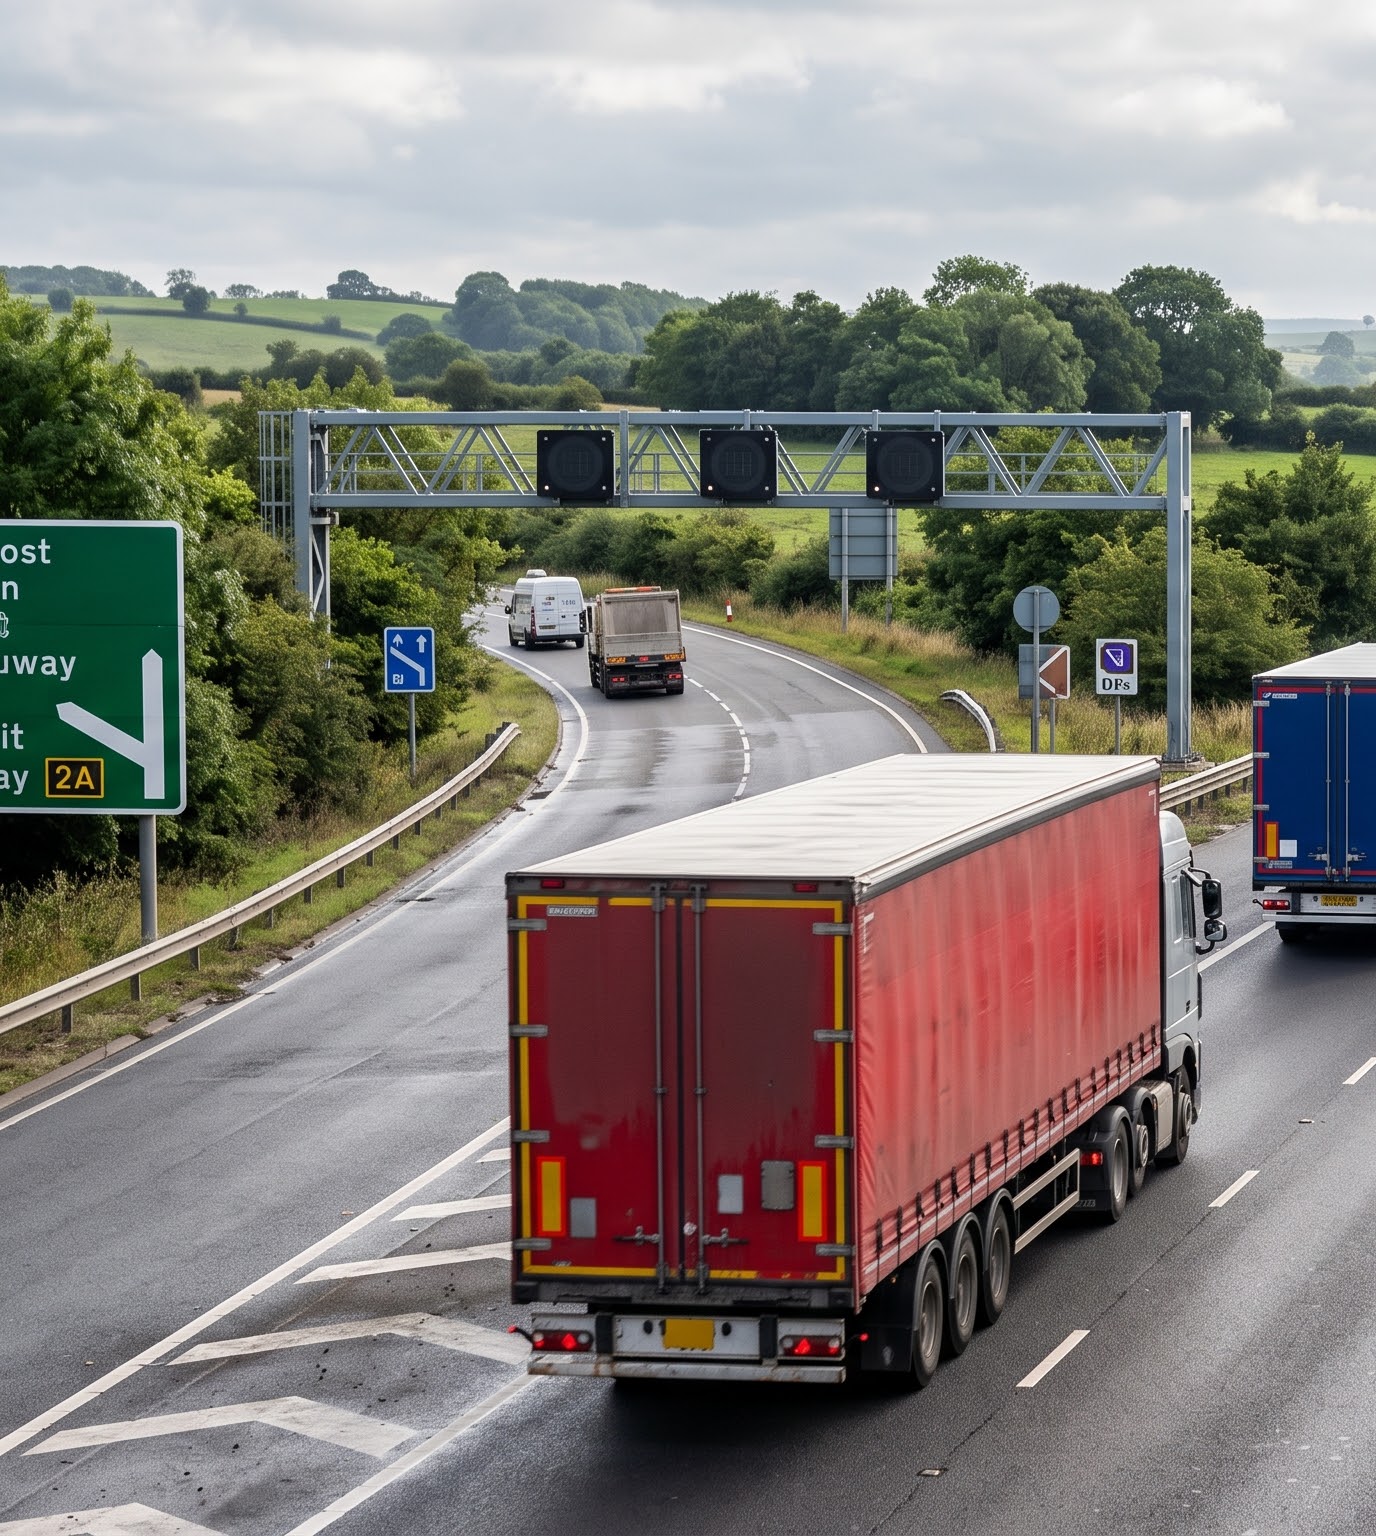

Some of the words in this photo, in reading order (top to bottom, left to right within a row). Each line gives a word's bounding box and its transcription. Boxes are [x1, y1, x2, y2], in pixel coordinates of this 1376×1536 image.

[0, 538, 51, 565] ost
[2, 580, 19, 600] n
[2, 722, 24, 750] it
[55, 764, 95, 790] 2A
